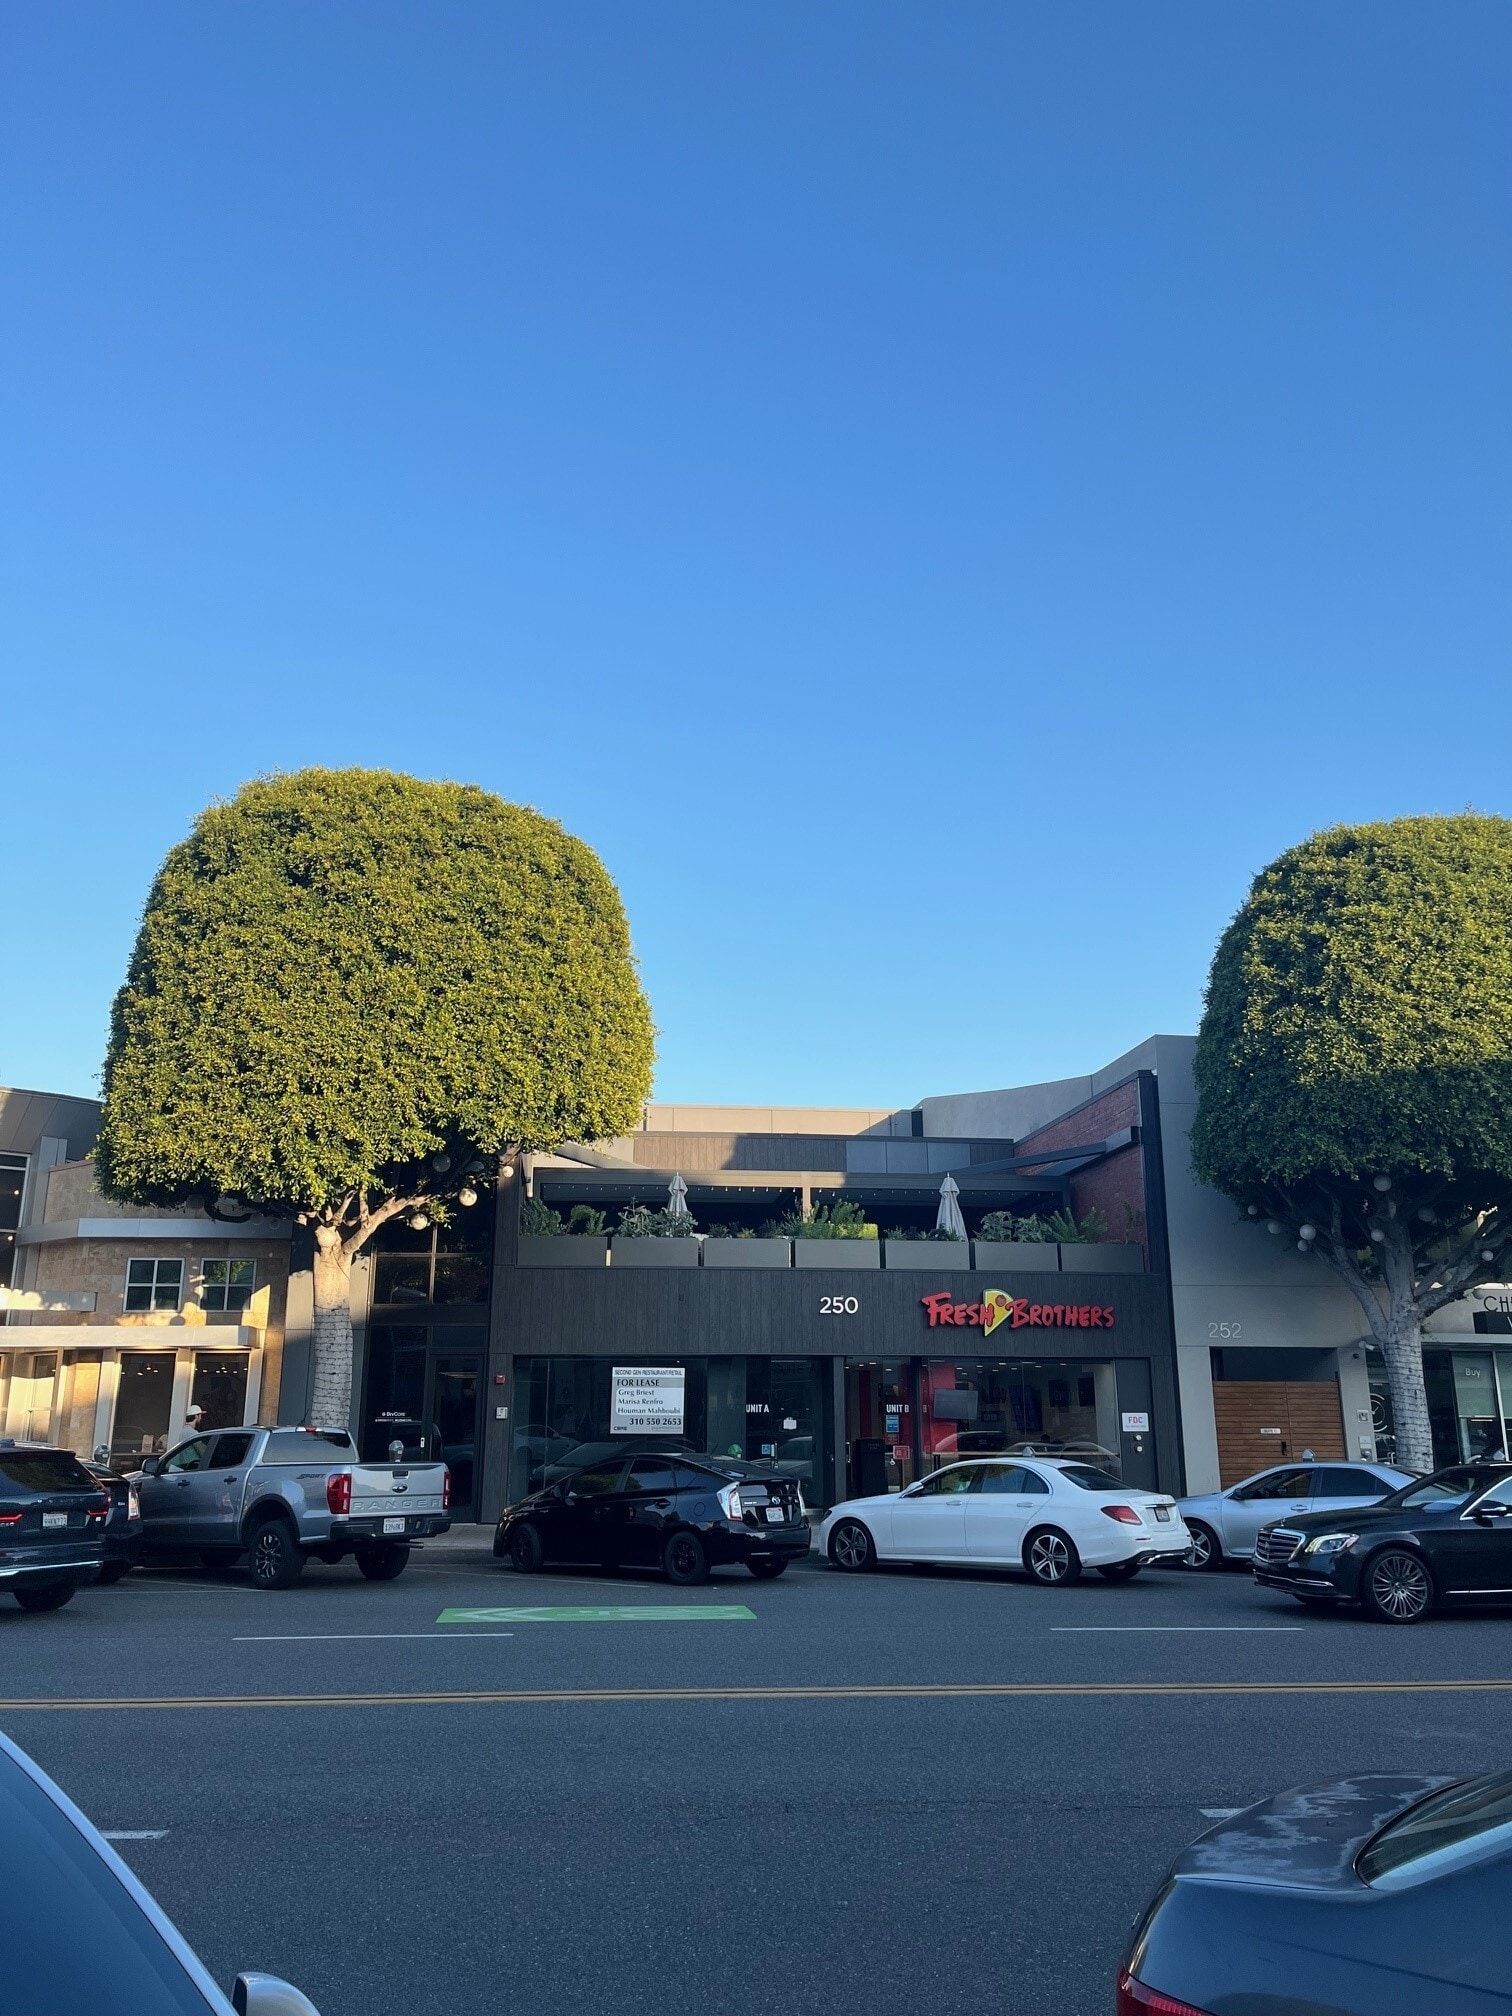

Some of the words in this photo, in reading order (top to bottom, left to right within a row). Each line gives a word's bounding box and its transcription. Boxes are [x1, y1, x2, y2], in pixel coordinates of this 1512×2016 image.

[819, 1296, 859, 1314] 250
[1483, 1296, 1512, 1313] CH
[921, 1292, 996, 1327] FRESH
[1005, 1298, 1115, 1329] BROTHERS
[1208, 1322, 1242, 1339] 252
[1465, 1368, 1481, 1379] Buy
[745, 1404, 763, 1413] UNIT
[763, 1404, 770, 1413] A
[886, 1404, 903, 1413] UNIT
[904, 1404, 910, 1413] B
[629, 1418, 644, 1426] 310
[646, 1418, 661, 1426] 550
[662, 1418, 682, 1426] 2653
[1128, 1416, 1143, 1424] FDC
[352, 1499, 441, 1511] RANGER
